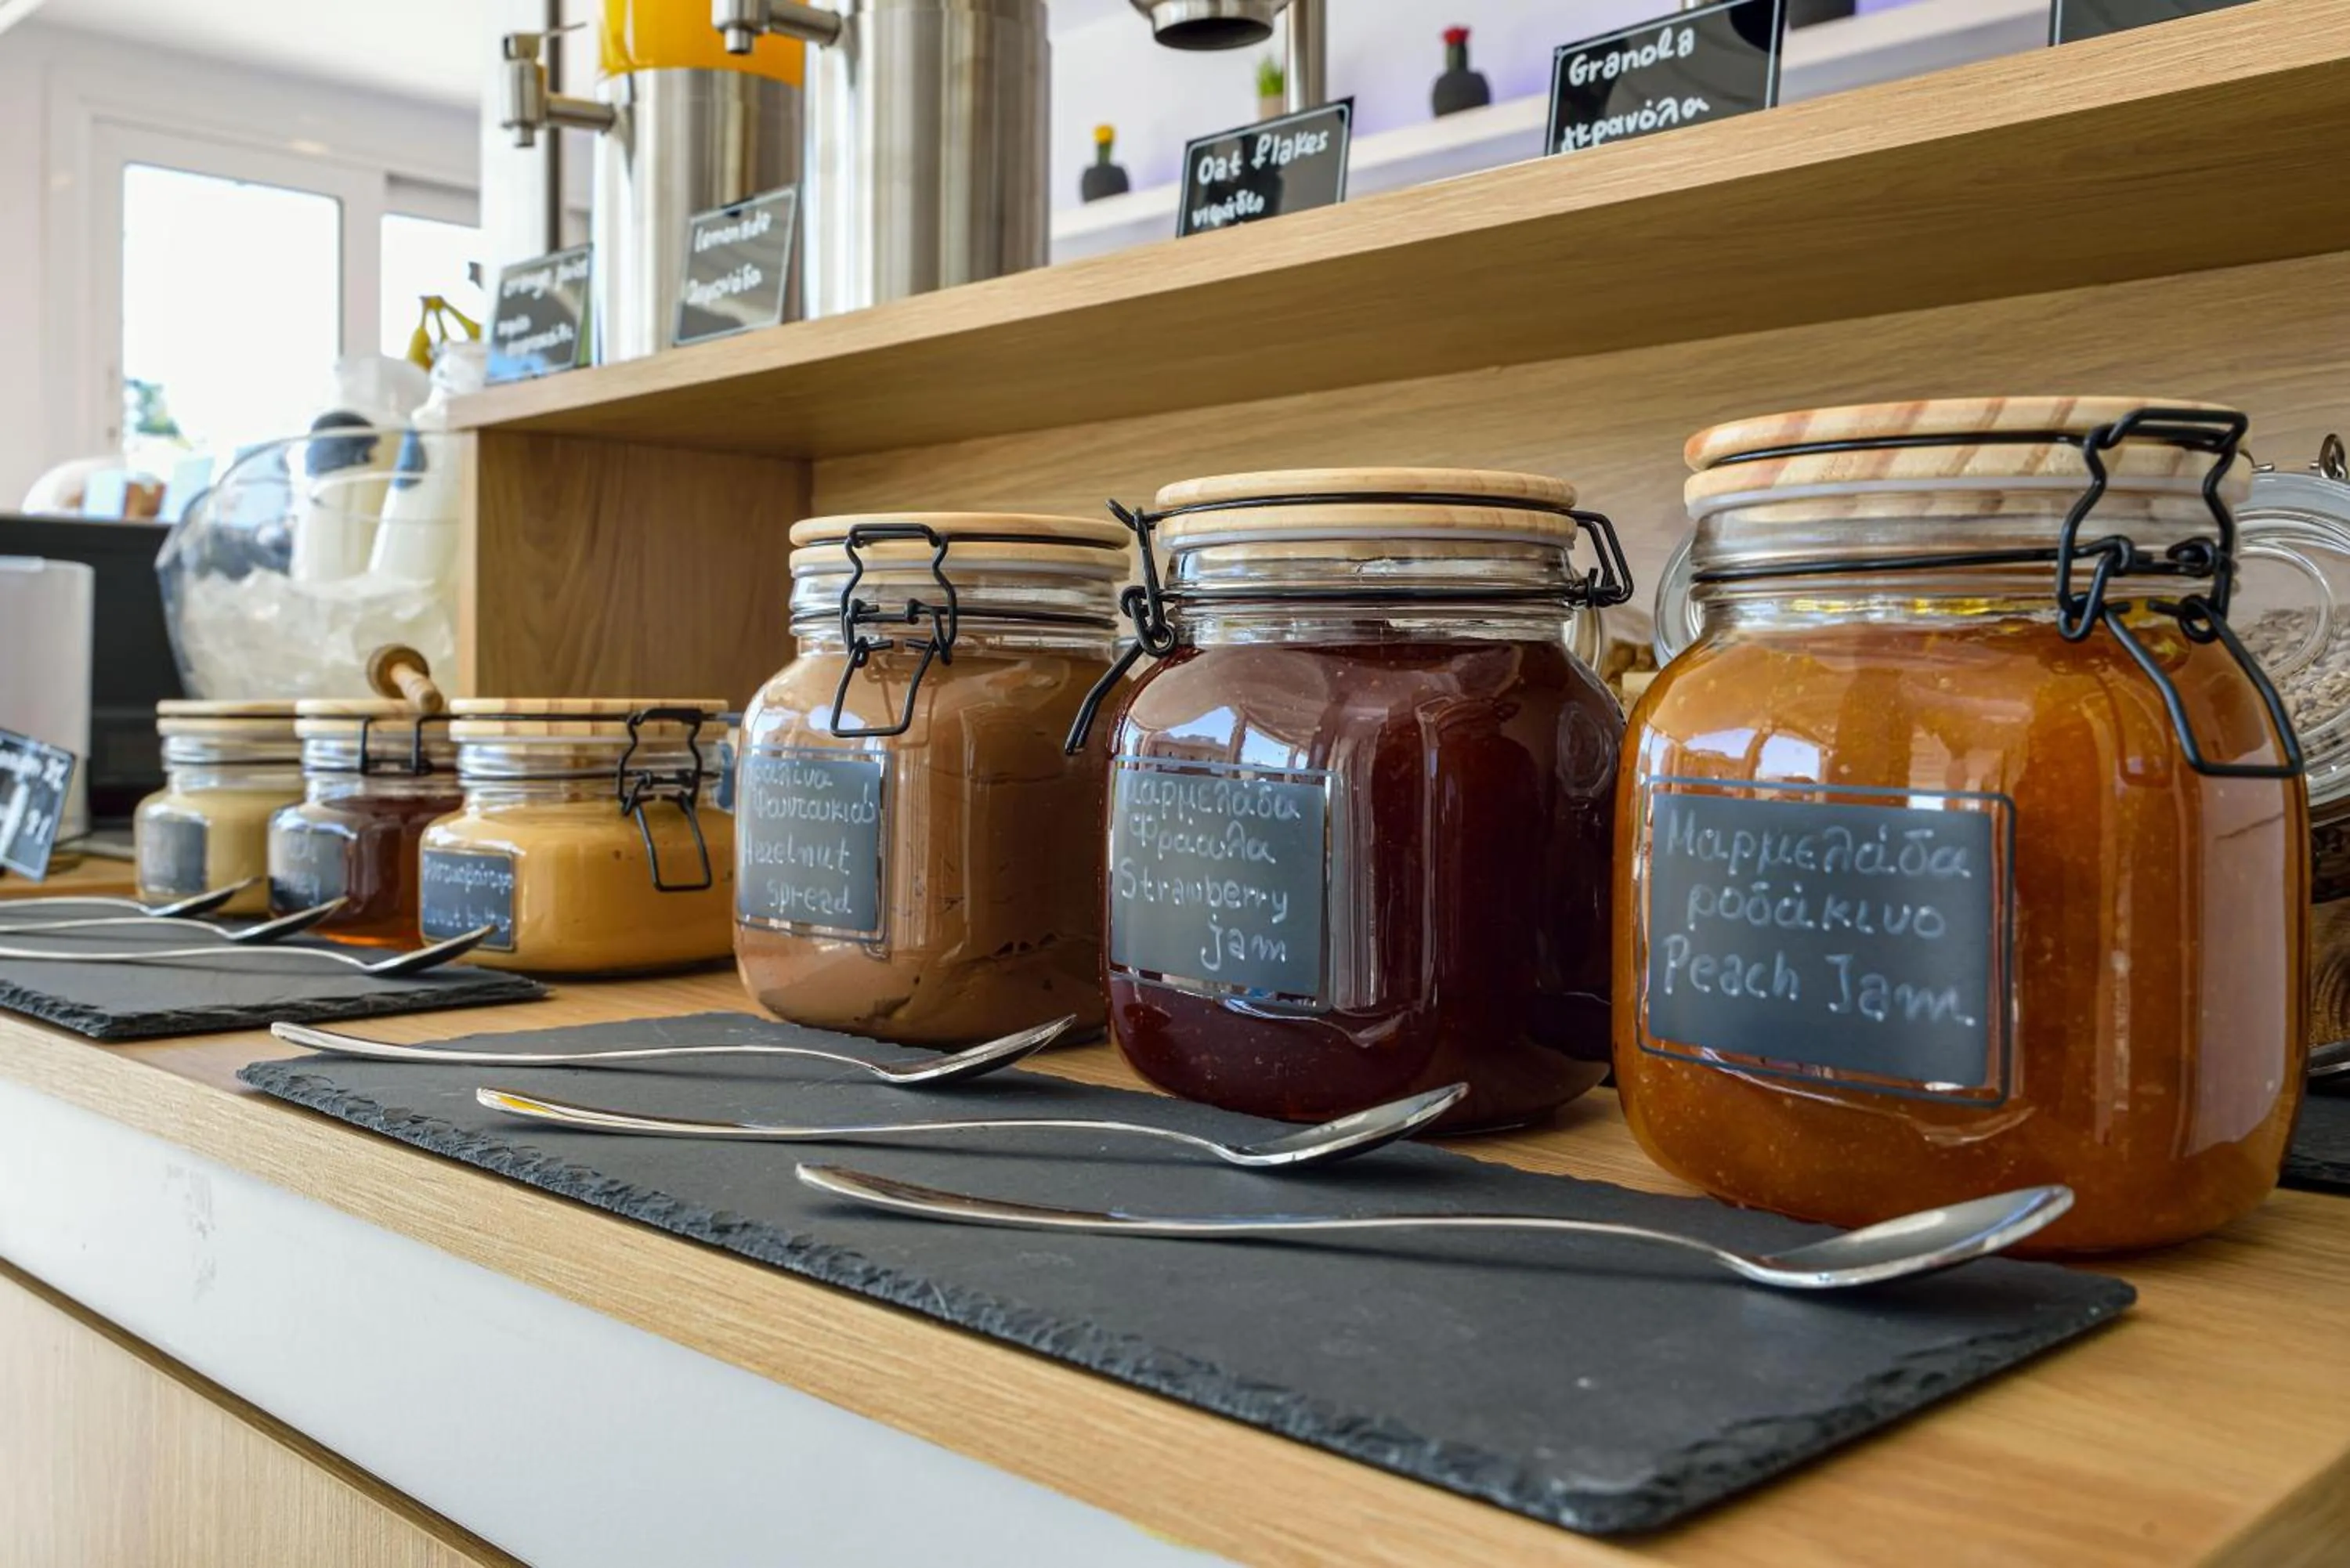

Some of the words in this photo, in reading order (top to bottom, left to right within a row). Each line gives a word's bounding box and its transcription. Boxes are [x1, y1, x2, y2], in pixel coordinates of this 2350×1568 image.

[1569, 27, 1695, 86] Granola
[1198, 149, 1242, 185] Oat
[1661, 934, 1799, 1001] Peach
